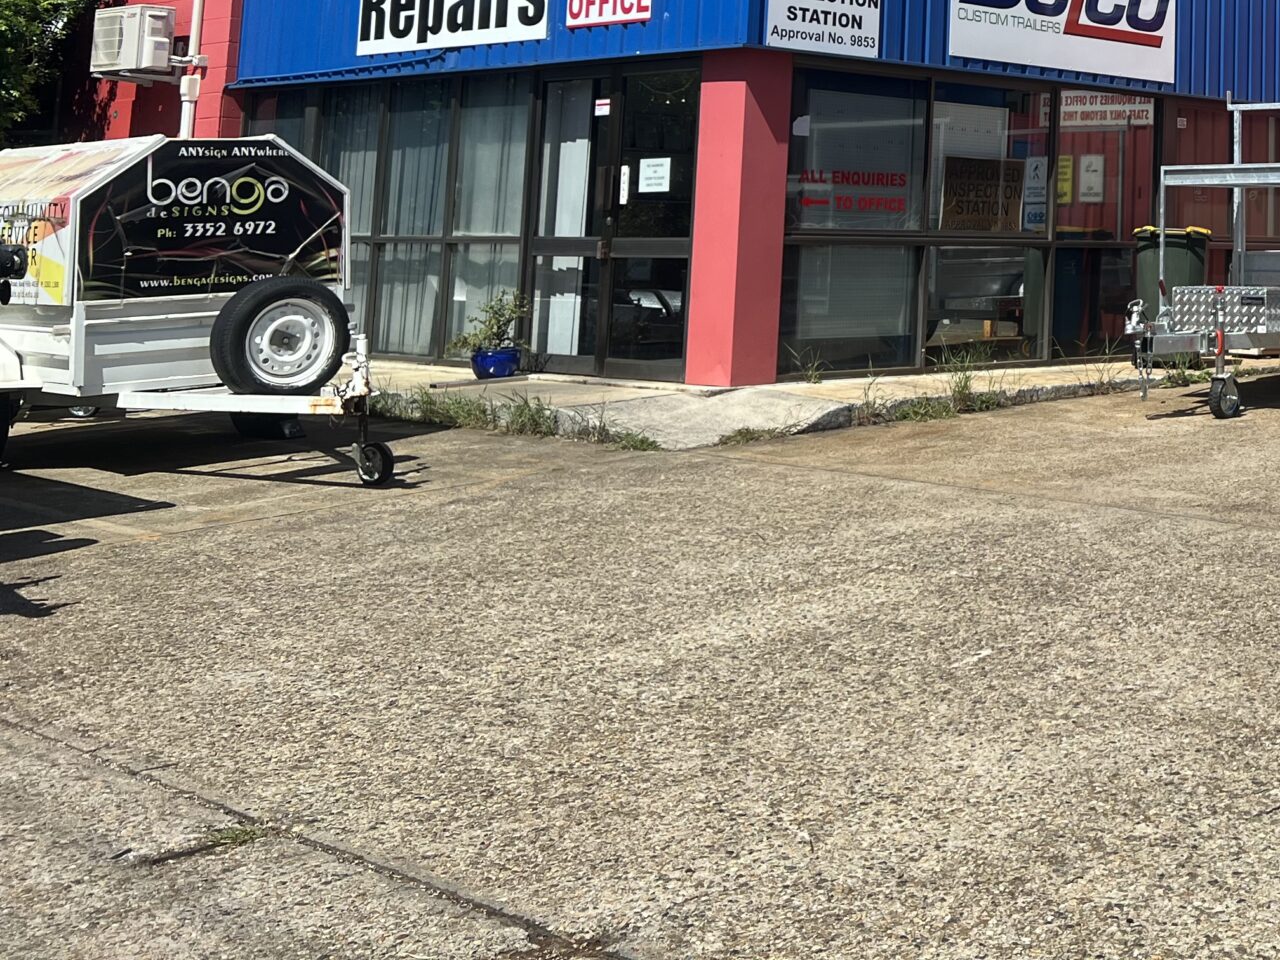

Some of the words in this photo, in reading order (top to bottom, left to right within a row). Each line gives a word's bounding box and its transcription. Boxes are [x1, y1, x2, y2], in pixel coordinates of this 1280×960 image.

[786, 5, 863, 30] STATION
[957, 7, 1008, 26] CUSTOM
[1010, 15, 1061, 34] TRAILERS
[770, 25, 824, 42] Approval
[828, 31, 847, 45] No.
[850, 34, 876, 49] 9853
[146, 155, 290, 215] benga
[799, 169, 827, 183] ALL
[831, 170, 907, 187] ENQUIRIES
[946, 182, 1021, 199] INSPECTON
[0, 203, 66, 223] OMMUNITY
[834, 196, 853, 209] TO
[857, 196, 906, 212] OFFICE
[157, 228, 176, 238] Ph:
[183, 222, 226, 237] 3352
[233, 221, 276, 235] 6972
